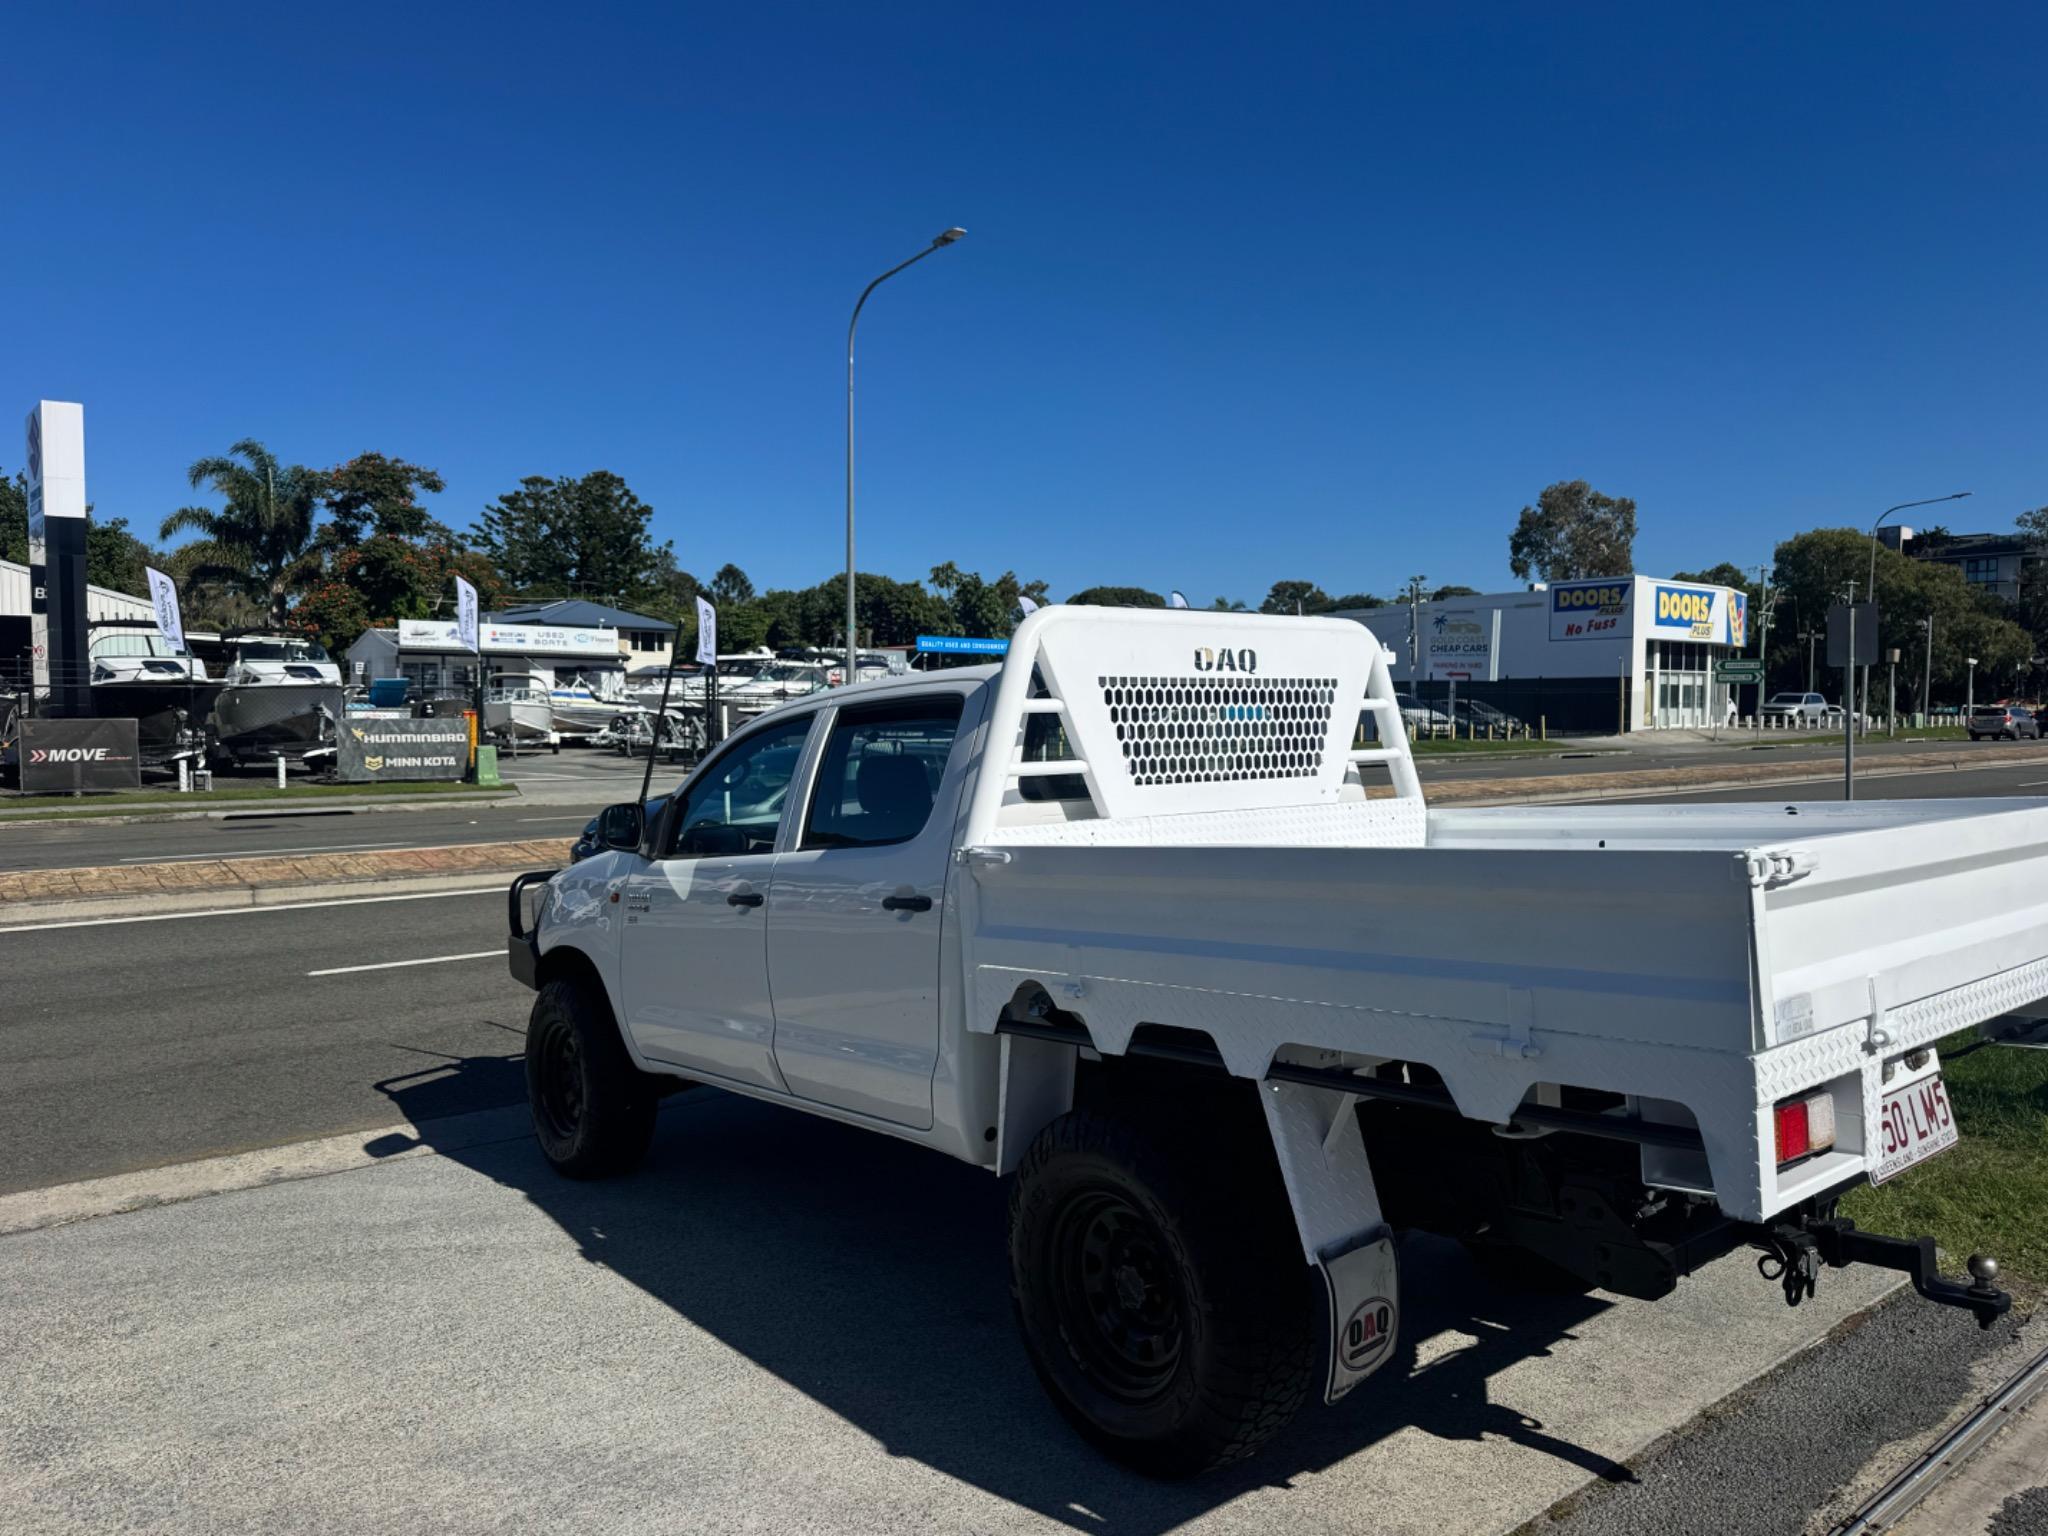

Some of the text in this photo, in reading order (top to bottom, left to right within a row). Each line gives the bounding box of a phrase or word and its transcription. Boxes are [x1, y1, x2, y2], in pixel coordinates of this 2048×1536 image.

[1558, 587, 1621, 608] DOORS
[1600, 604, 1625, 614] PLUS
[1659, 592, 1709, 622] DOORS
[1565, 618, 1617, 636] No Fuss
[1692, 625, 1712, 636] PLUS
[537, 631, 565, 640] USED
[534, 639, 568, 647] BOATS
[960, 642, 971, 650] AND
[1430, 643, 1488, 653] CHEAP CARS
[1194, 647, 1257, 675] OAQ
[48, 748, 111, 762] MOVE
[385, 756, 457, 768] MINN KOTA
[1349, 1306, 1389, 1347] OAQ
